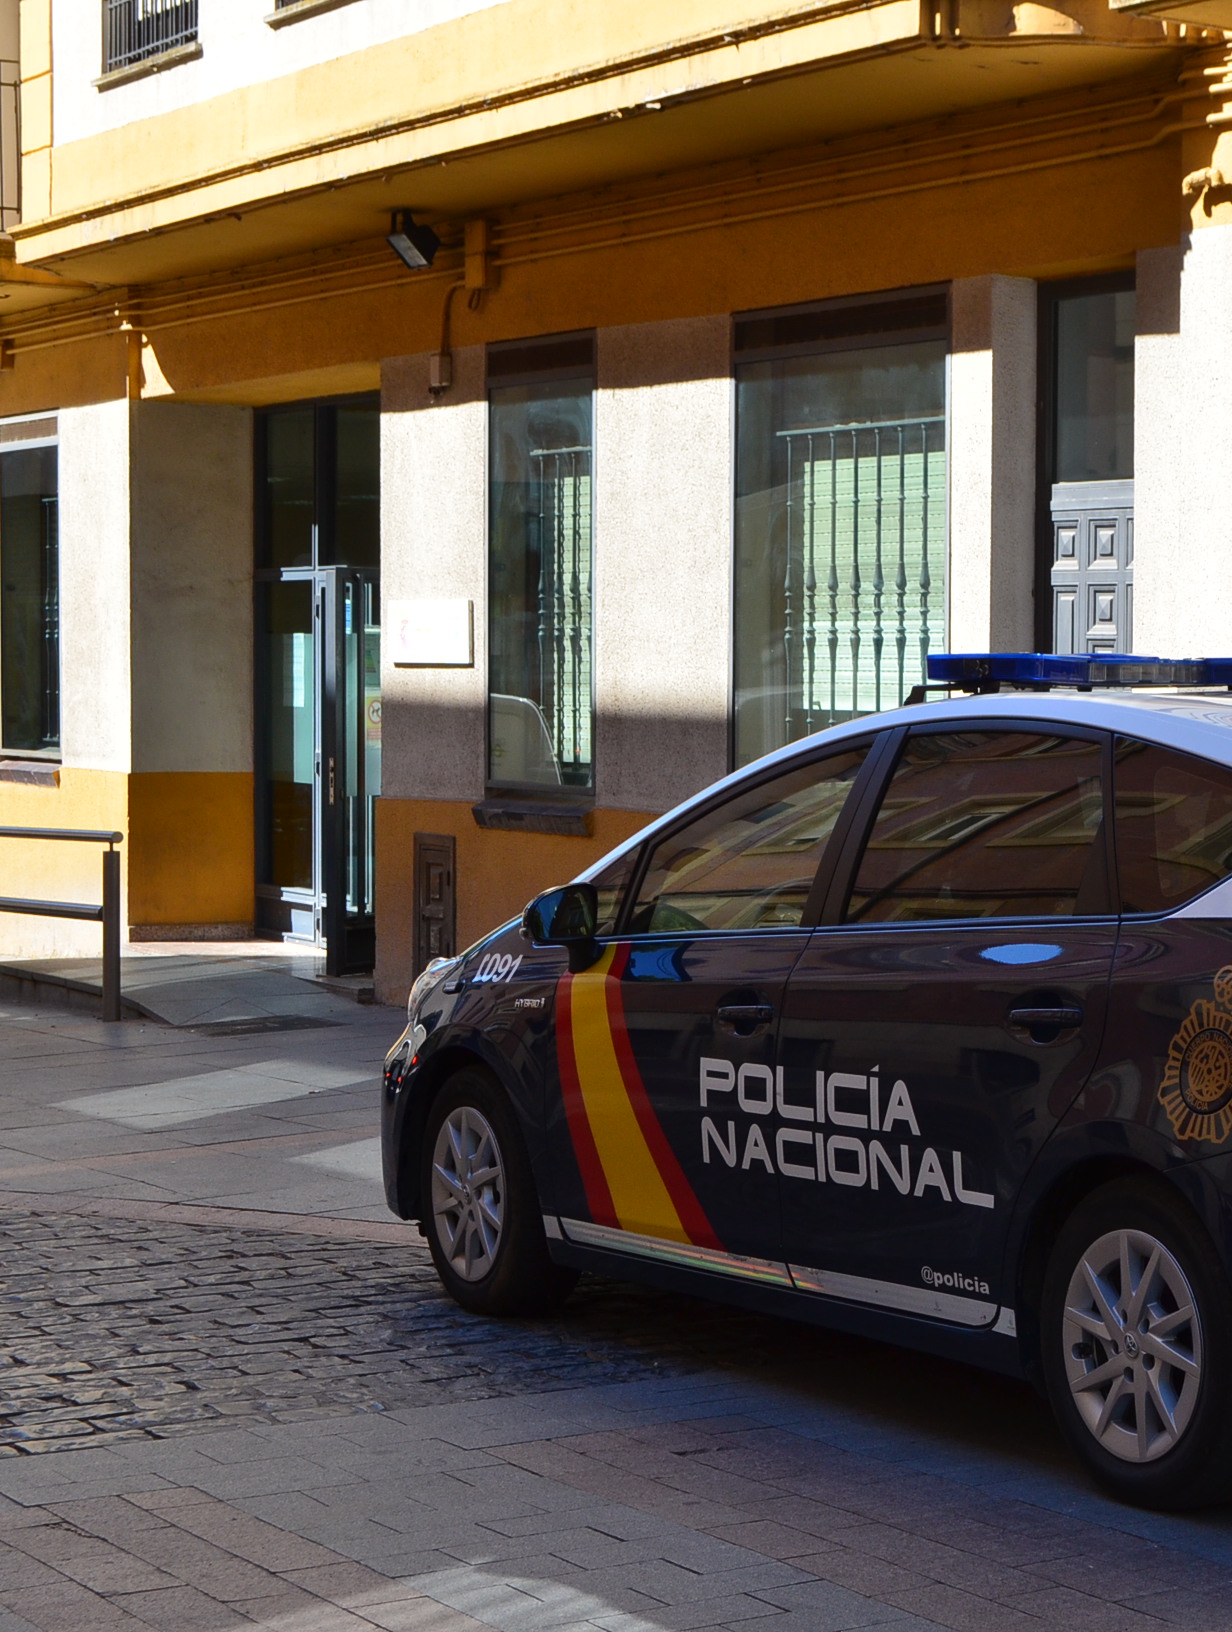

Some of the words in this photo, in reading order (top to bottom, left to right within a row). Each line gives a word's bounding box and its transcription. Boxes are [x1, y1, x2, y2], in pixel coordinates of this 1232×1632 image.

[699, 1056, 921, 1136] POLICÍA
[701, 1116, 995, 1209] NACIONAL
[921, 1265, 990, 1295] @policia
